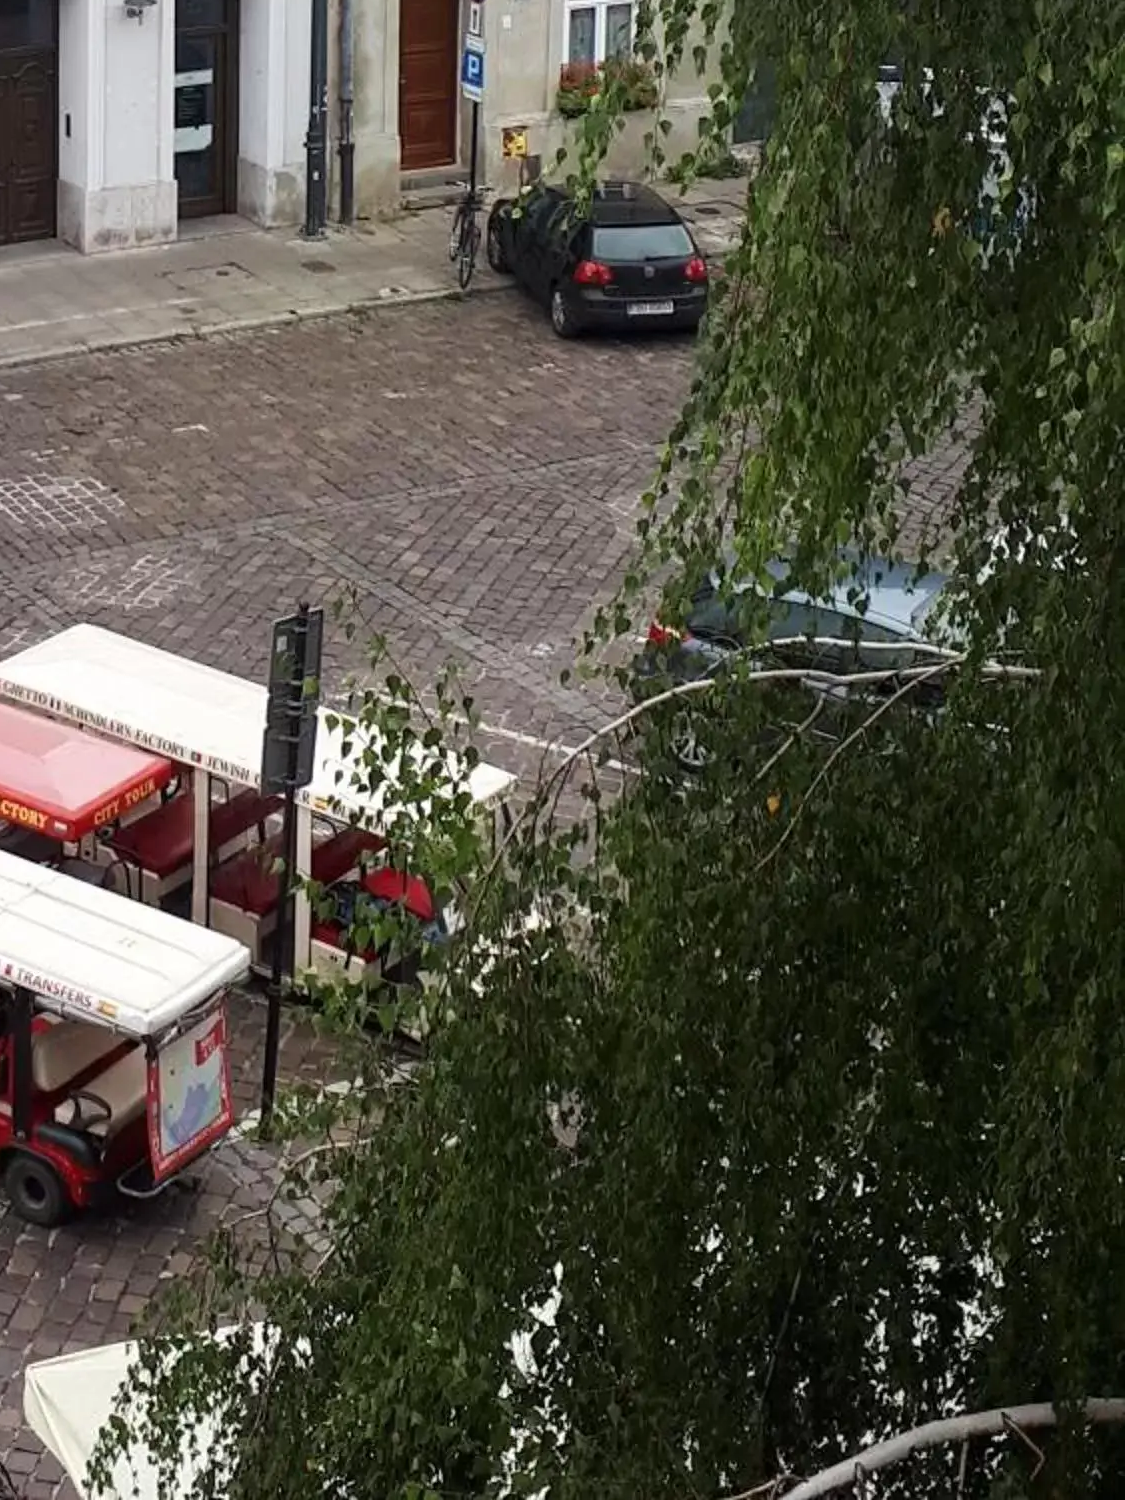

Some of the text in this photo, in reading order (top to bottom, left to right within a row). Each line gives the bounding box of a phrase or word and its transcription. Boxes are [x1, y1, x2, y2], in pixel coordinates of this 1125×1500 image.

[467, 53, 480, 78] P
[134, 728, 187, 758] FACTORY
[206, 757, 250, 780] JEWISH
[94, 778, 156, 826] CITY TOUR
[15, 967, 93, 1008] TRANSFERS
